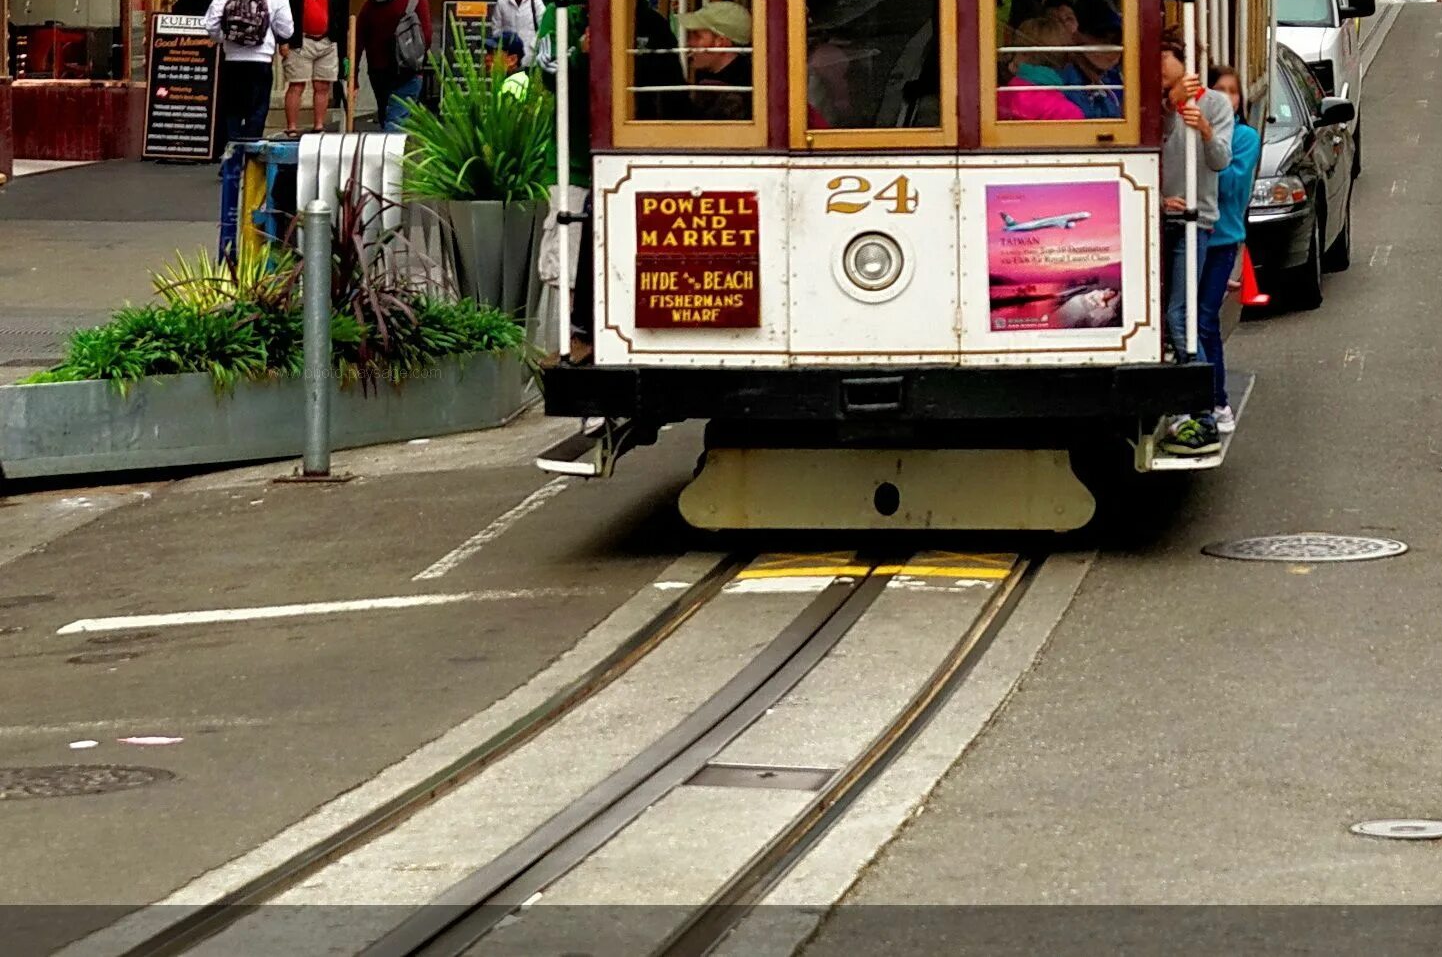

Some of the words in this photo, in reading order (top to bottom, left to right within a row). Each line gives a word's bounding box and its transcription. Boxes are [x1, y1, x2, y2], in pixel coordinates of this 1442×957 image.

[826, 174, 919, 214] 24
[643, 198, 753, 215] POWELL
[671, 216, 727, 229] AND
[641, 230, 755, 246] MARKET
[640, 271, 679, 290] HYDE
[703, 270, 754, 290] BEACH
[650, 294, 744, 308] FISHERMANS
[671, 308, 720, 322] WHARF
